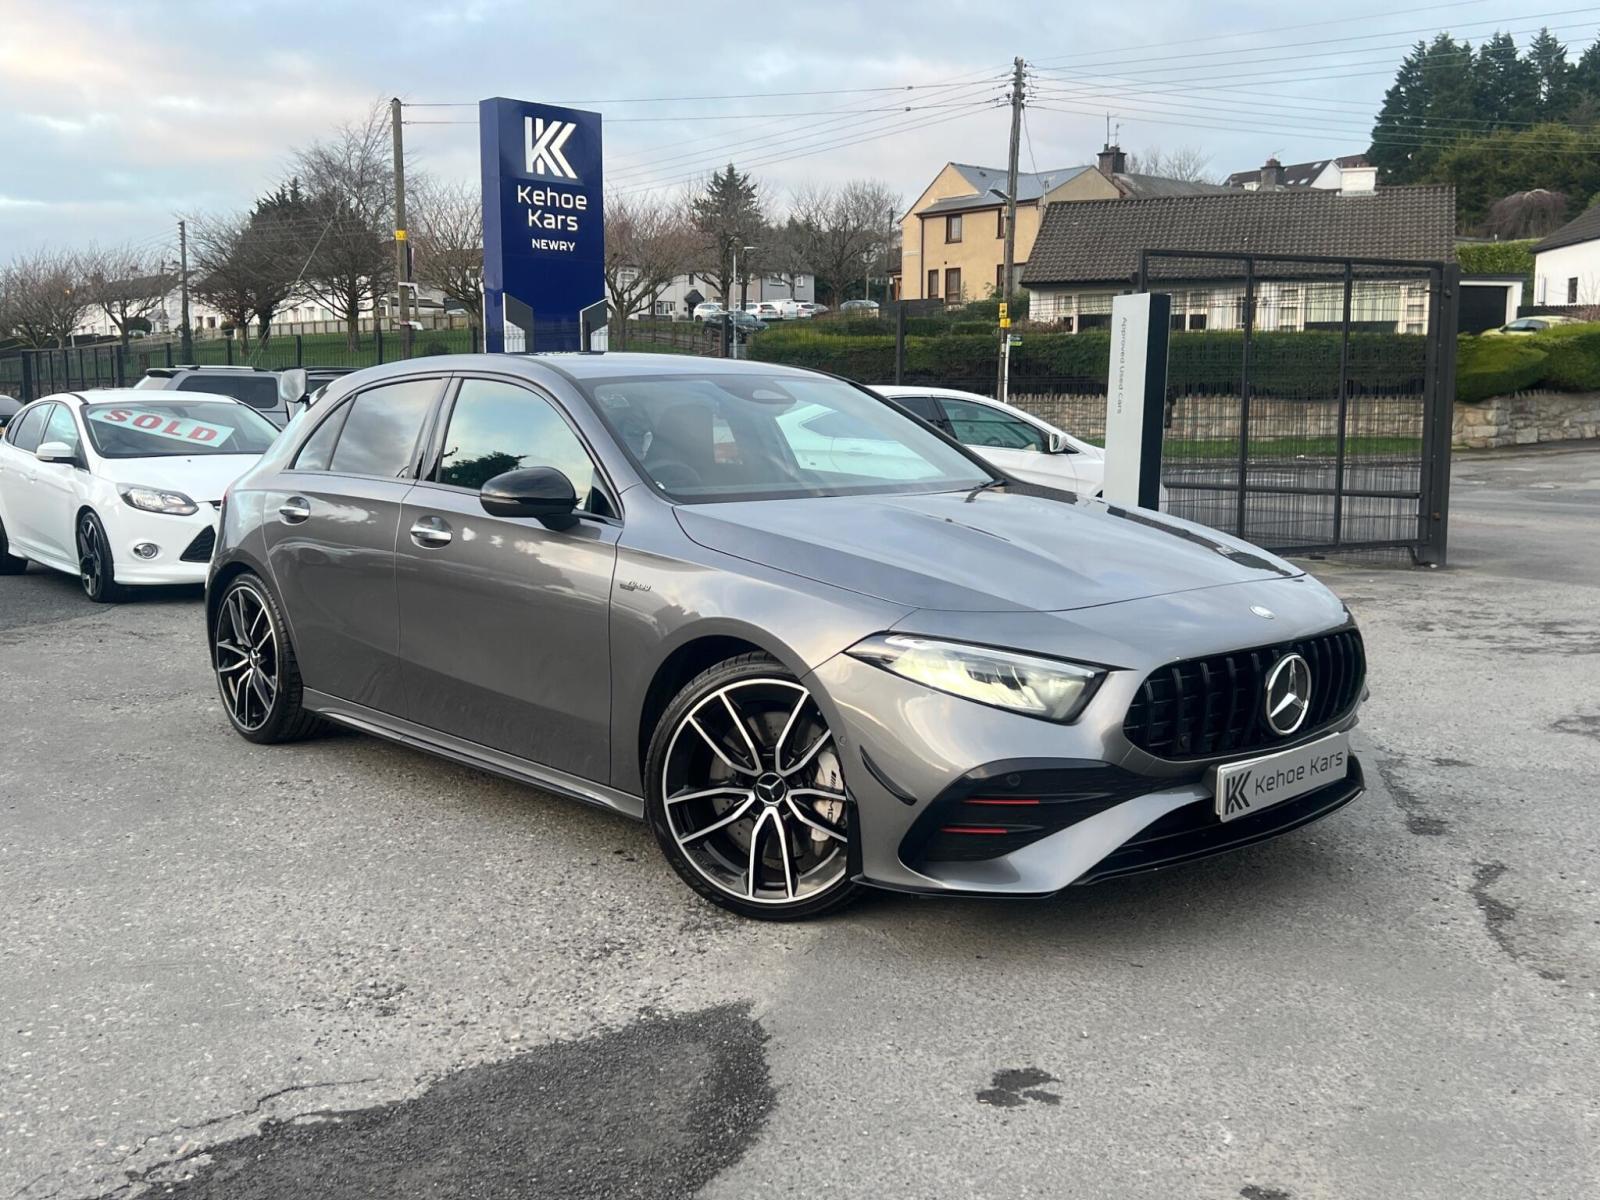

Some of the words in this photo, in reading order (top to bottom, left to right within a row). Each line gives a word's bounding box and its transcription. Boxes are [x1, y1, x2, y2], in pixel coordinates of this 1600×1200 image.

[517, 184, 587, 210] Kehoe
[527, 208, 579, 231] Kars
[531, 238, 576, 252] NEWRY
[1120, 316, 1128, 364] Approved
[103, 408, 218, 442] SOLD
[1255, 765, 1305, 796] Kehoe
[1310, 751, 1343, 776] Kars
